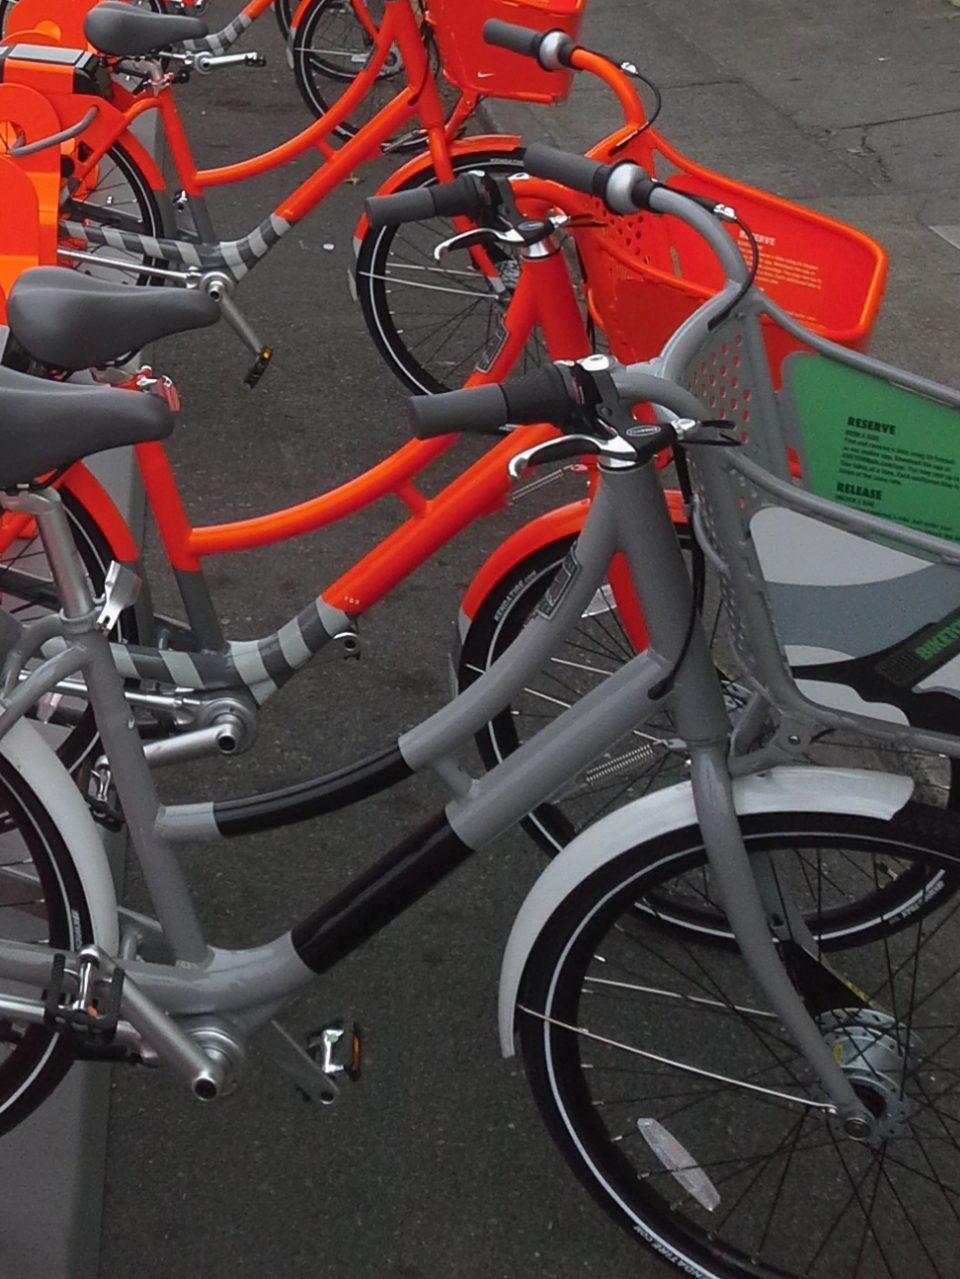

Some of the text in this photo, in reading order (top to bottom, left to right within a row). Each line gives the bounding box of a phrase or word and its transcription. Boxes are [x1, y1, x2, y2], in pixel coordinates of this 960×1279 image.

[739, 229, 775, 246] REERVE
[847, 416, 897, 436] RESERVE
[836, 481, 882, 500] RELEASE
